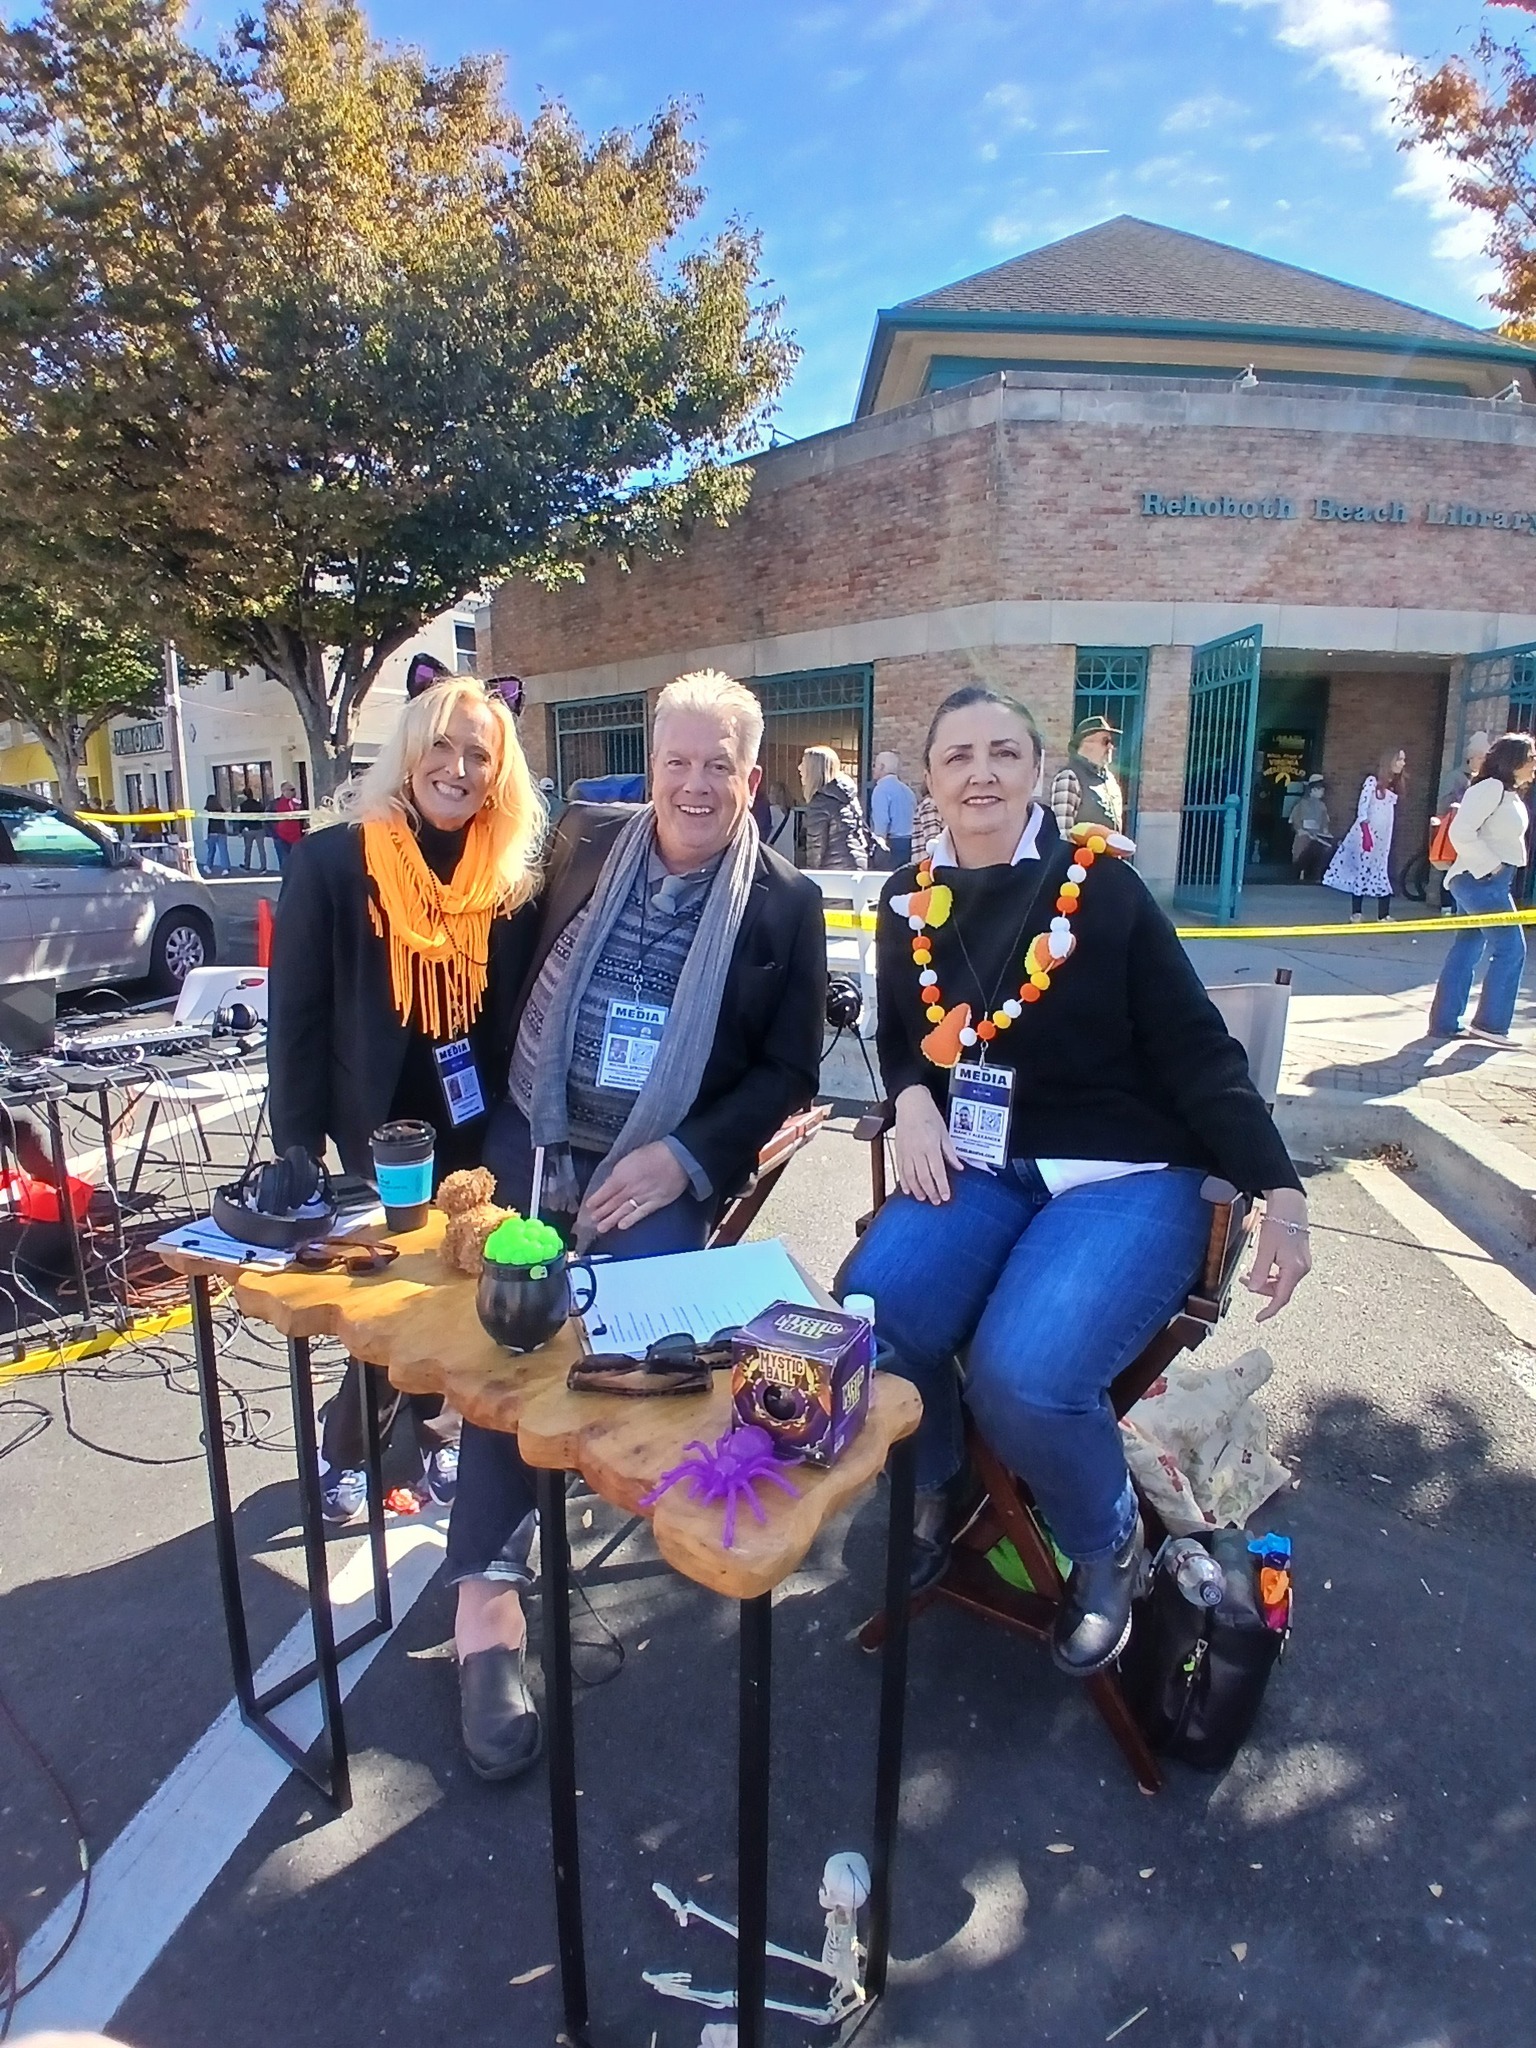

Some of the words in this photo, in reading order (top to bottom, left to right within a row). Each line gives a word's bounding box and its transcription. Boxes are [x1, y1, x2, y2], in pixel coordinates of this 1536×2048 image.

[1141, 491, 1297, 520] Rehoboth
[1312, 496, 1408, 524] Beach
[1424, 502, 1536, 535] Library
[616, 1006, 661, 1022] MEDIA
[439, 1042, 468, 1060] MEDIA
[959, 1068, 1008, 1086] MEDIA
[776, 1313, 842, 1333] MYSTIC
[781, 1322, 822, 1338] BALL
[760, 1351, 804, 1374] MYSTIC
[766, 1366, 794, 1385] BALL
